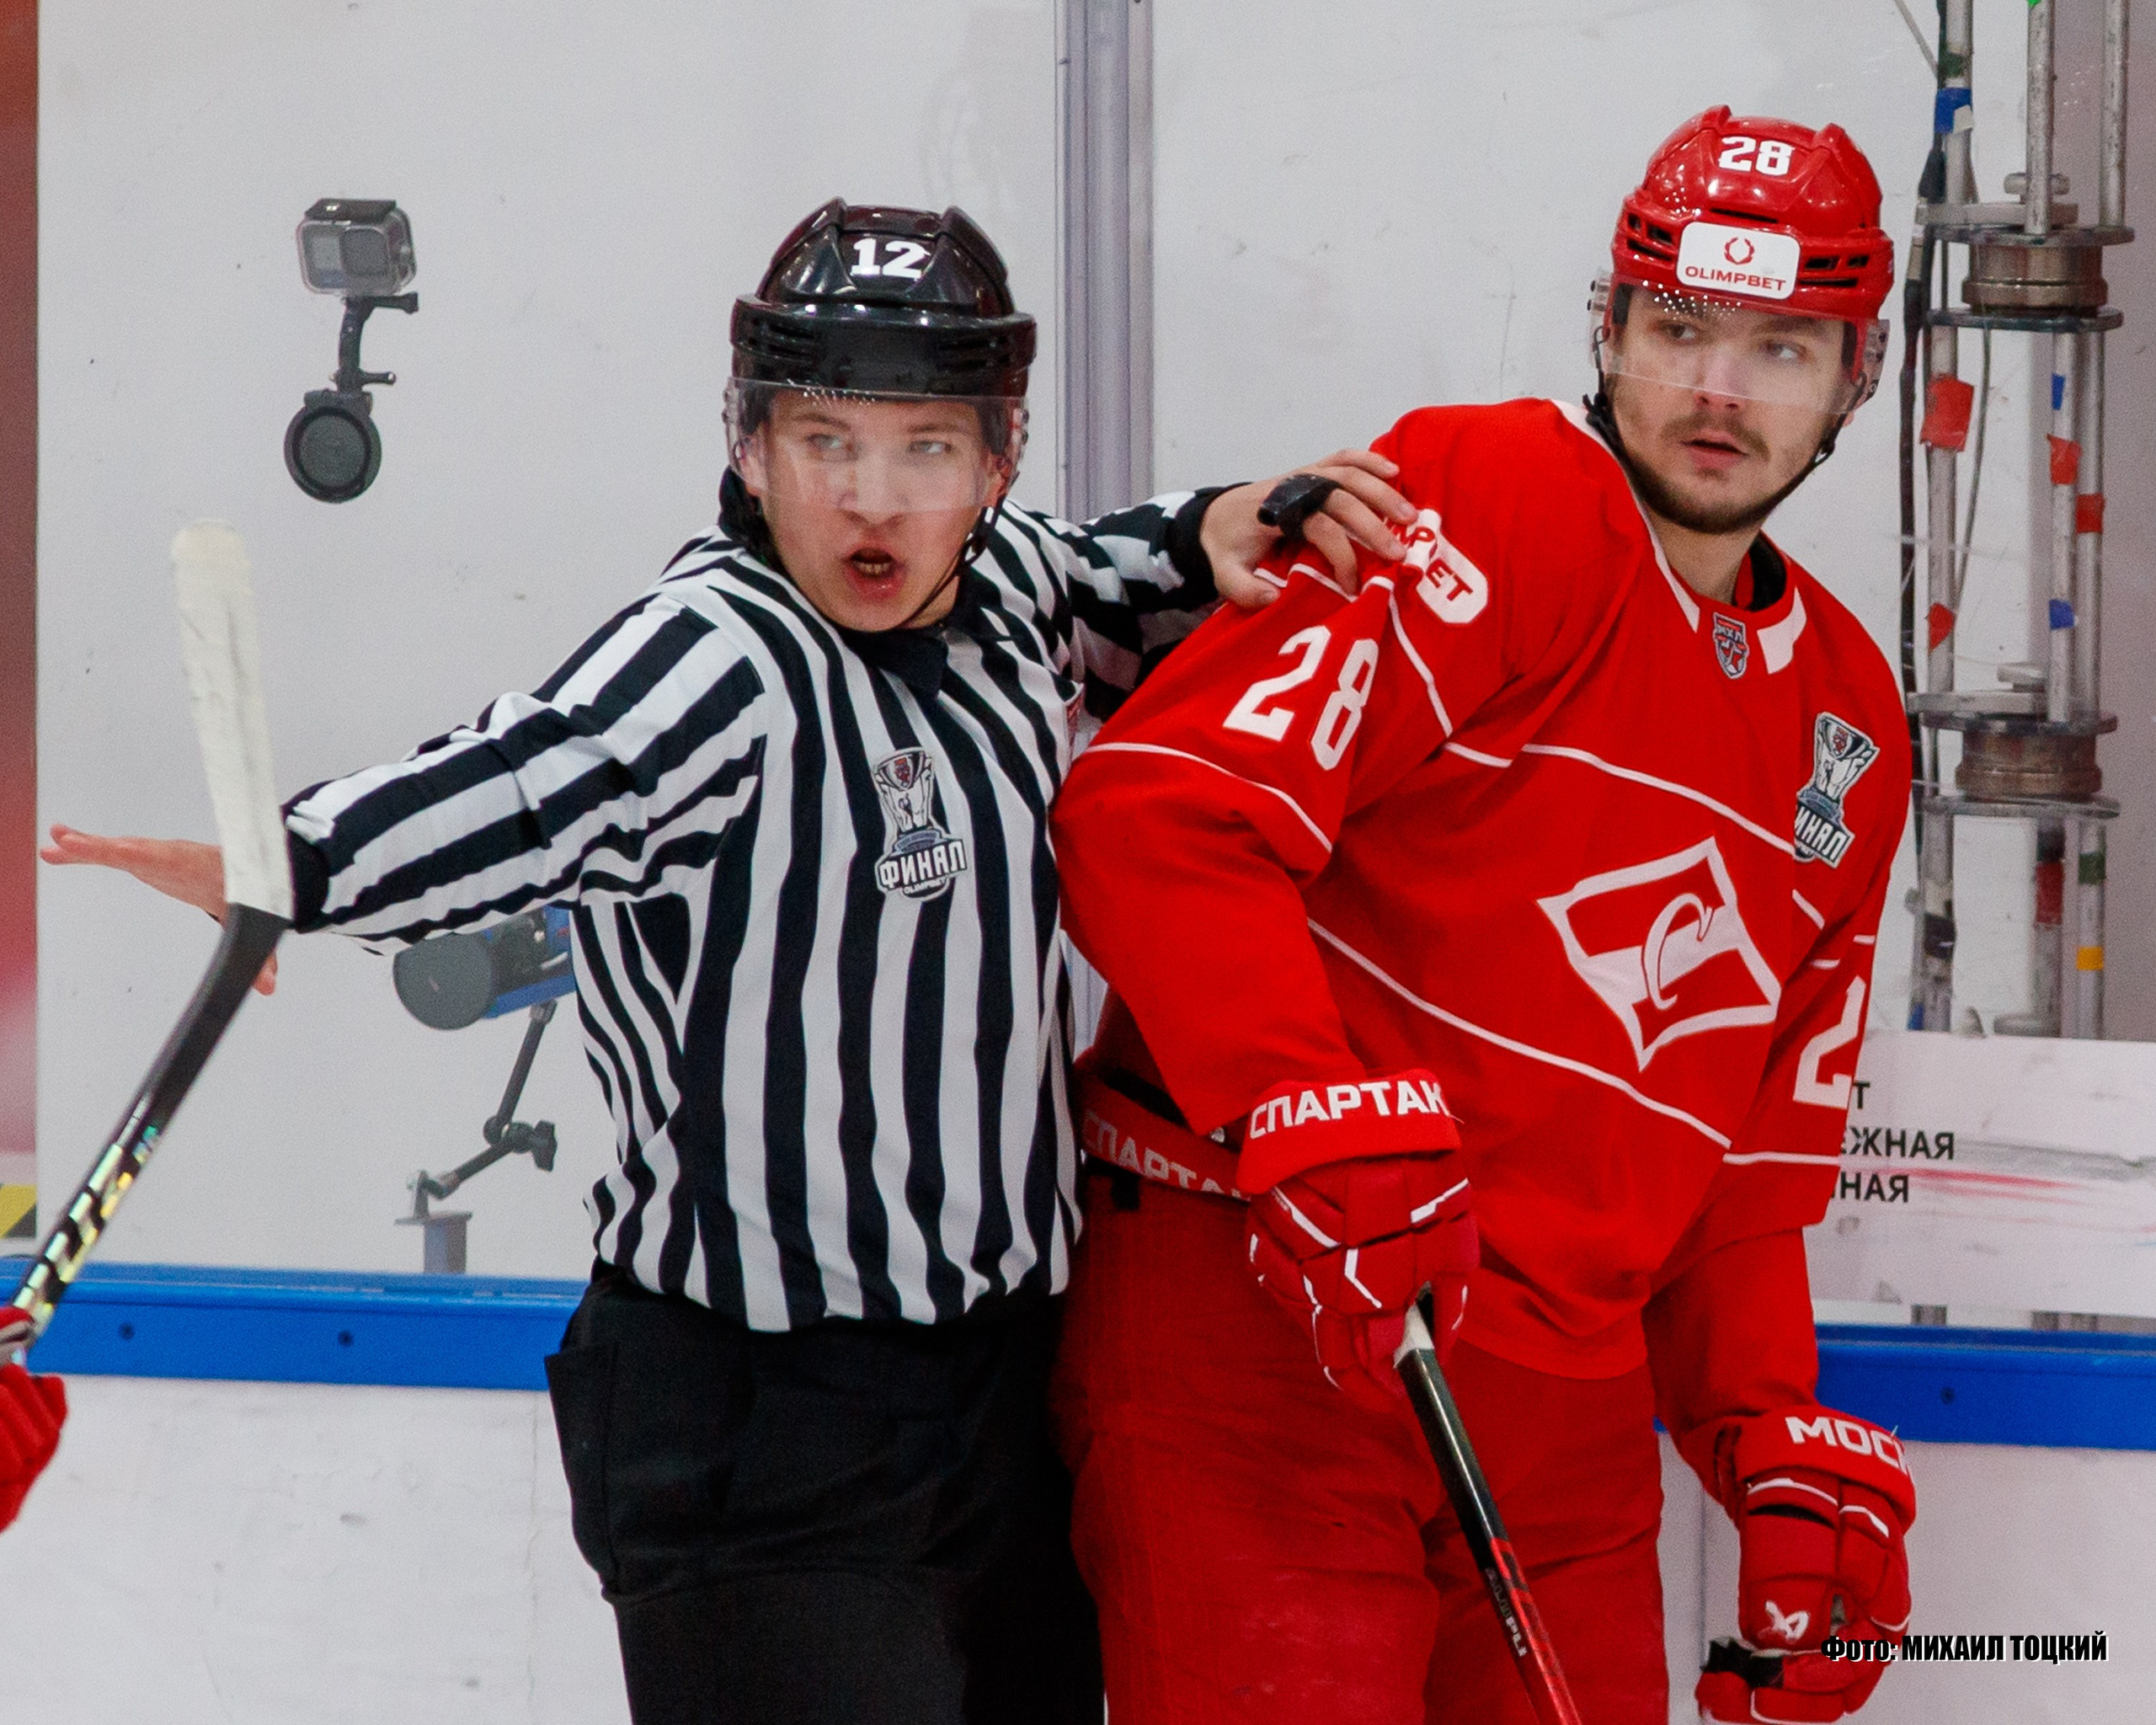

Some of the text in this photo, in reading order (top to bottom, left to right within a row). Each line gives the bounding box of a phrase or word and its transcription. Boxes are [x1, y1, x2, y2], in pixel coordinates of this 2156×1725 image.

[1718, 136, 1794, 176] 28
[851, 238, 927, 280] 12
[1685, 266, 1786, 291] OLIMPBET
[1222, 625, 1380, 772] 28
[1795, 806, 1848, 860] ИНАЛ
[879, 841, 966, 889] ФИНАЛ
[1792, 975, 1866, 1109] 2
[1250, 1079, 1451, 1140] СПАРТАК
[1083, 1108, 1251, 1202] СПАРТА
[1840, 1127, 1955, 1161] ЖНАЯ
[1832, 1171, 1909, 1203] НАЯ
